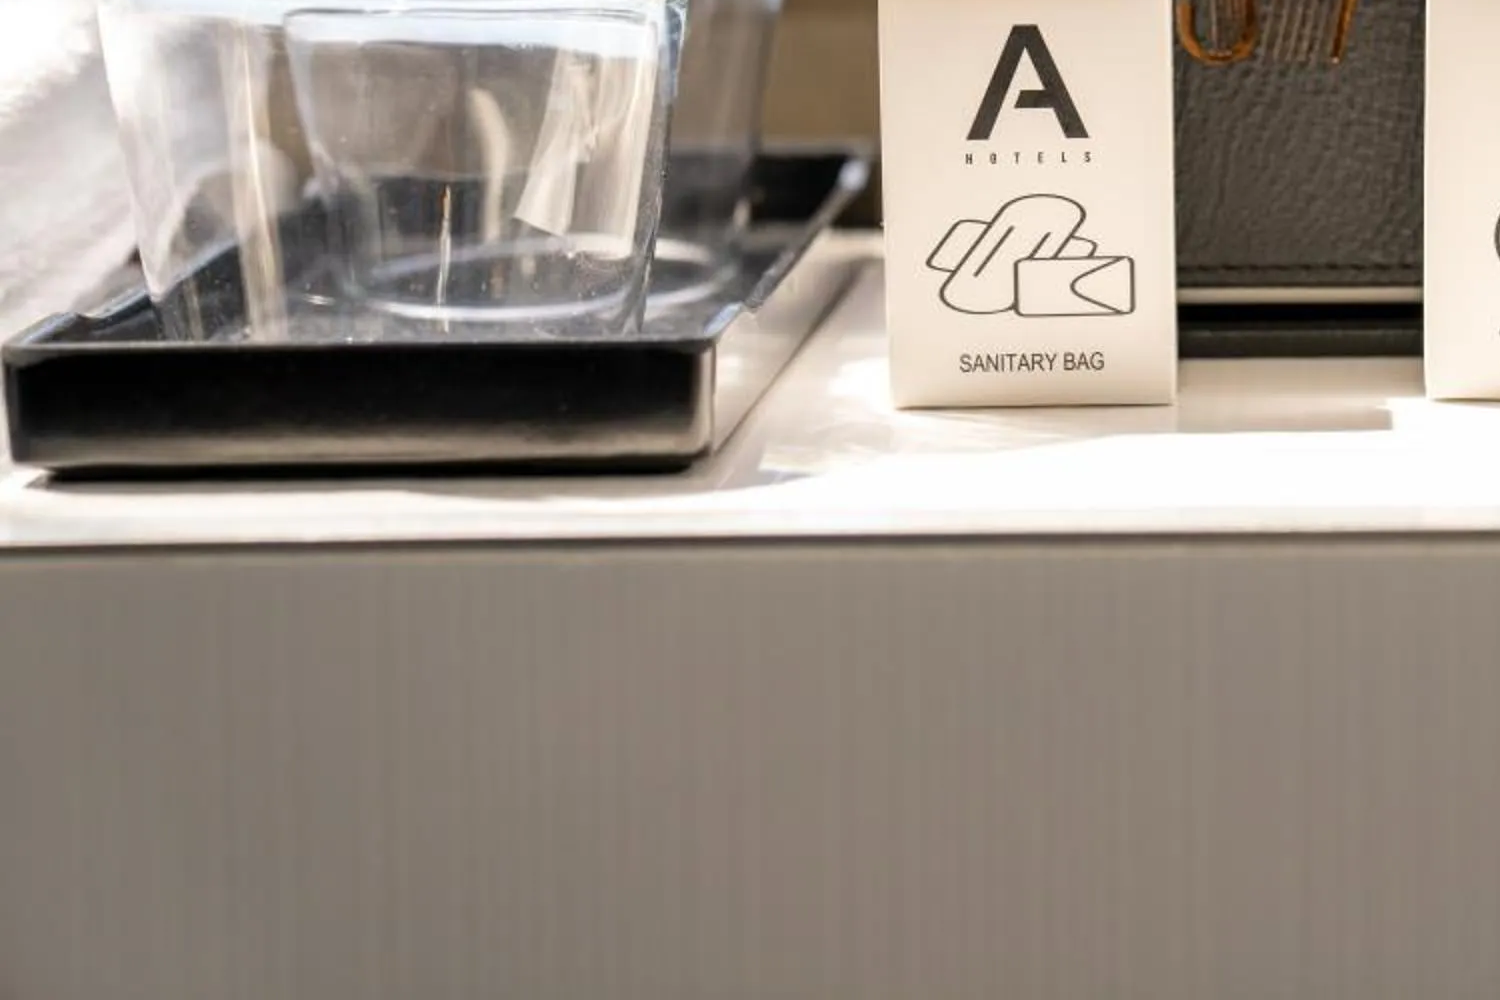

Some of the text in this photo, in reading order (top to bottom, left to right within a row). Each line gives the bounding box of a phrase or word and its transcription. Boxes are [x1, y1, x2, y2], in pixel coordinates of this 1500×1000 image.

[965, 23, 1091, 141] A
[965, 151, 1092, 165] HOTELS
[959, 351, 1105, 373] SANITARY BAG
